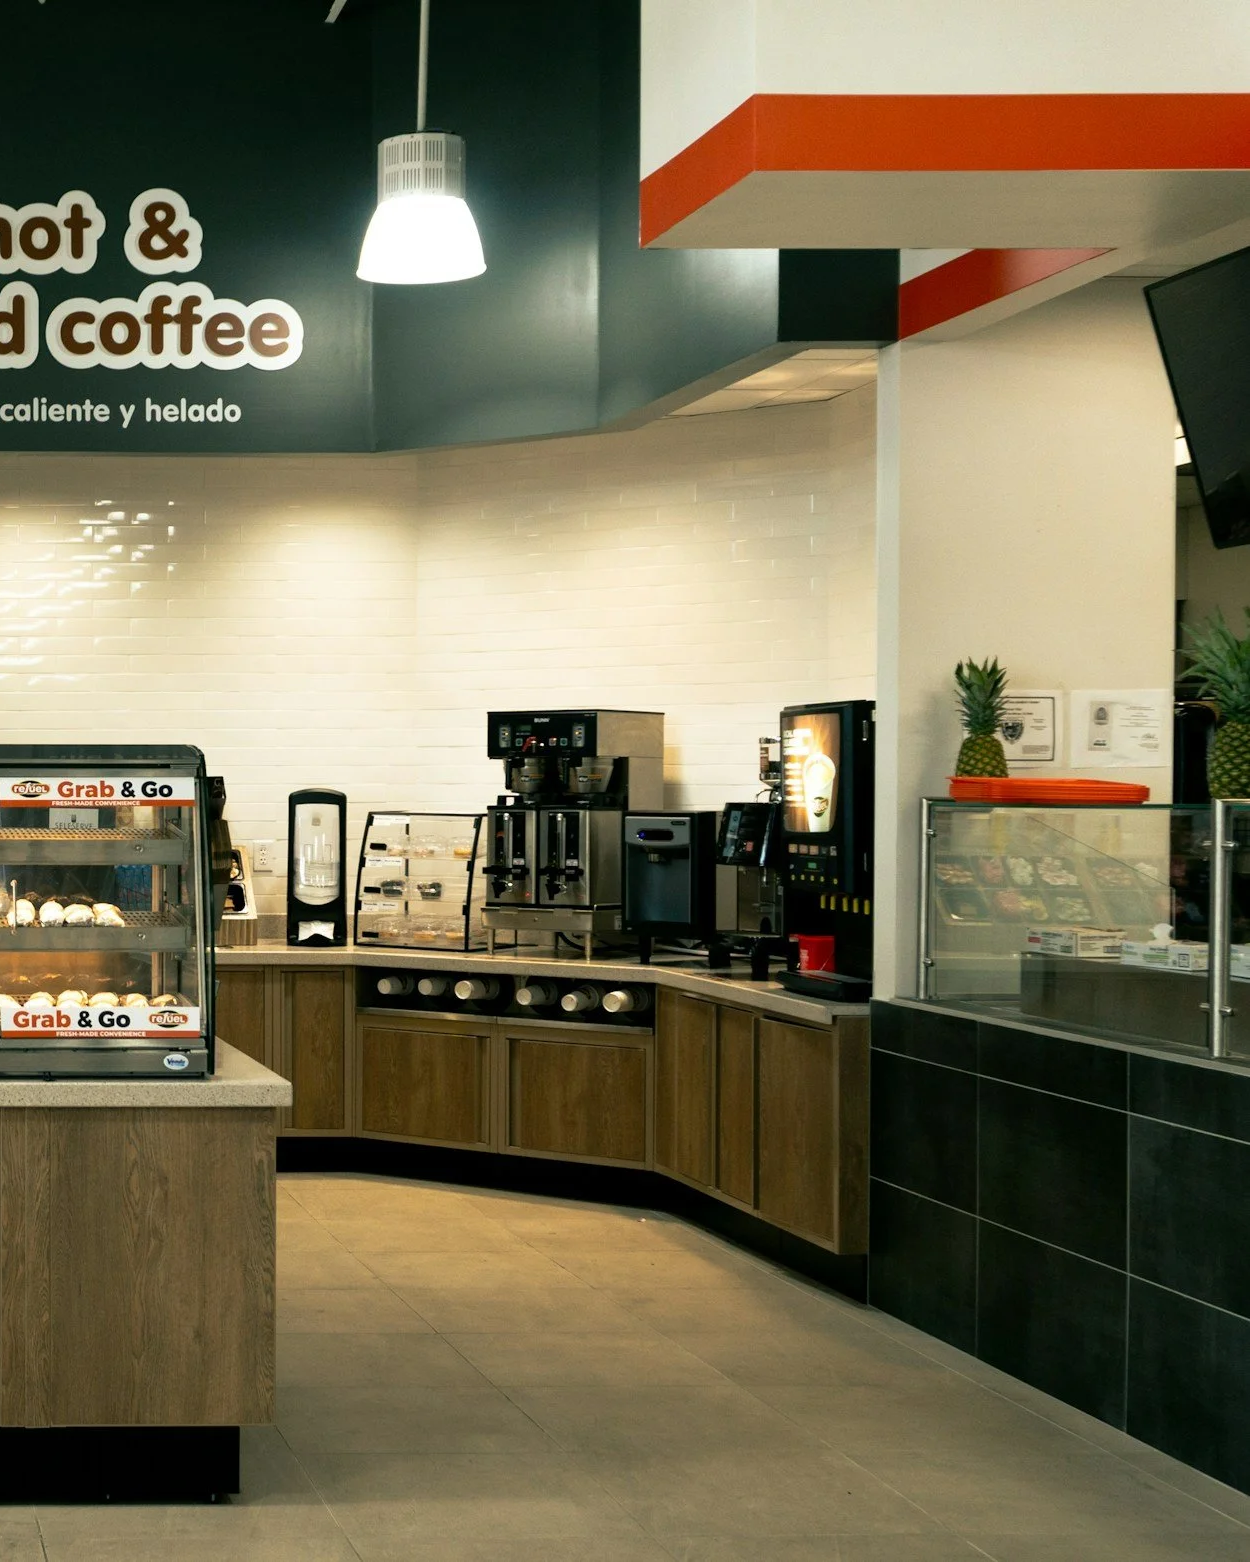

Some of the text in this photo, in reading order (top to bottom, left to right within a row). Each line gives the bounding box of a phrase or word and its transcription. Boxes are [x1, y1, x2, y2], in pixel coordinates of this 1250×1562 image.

[138, 200, 189, 260] &
[59, 294, 290, 357] coffee
[0, 397, 110, 422] caliente
[119, 402, 135, 428] y
[145, 397, 241, 423] helado
[57, 780, 173, 798] Grab & Go
[13, 1010, 131, 1028] Grab & Go
